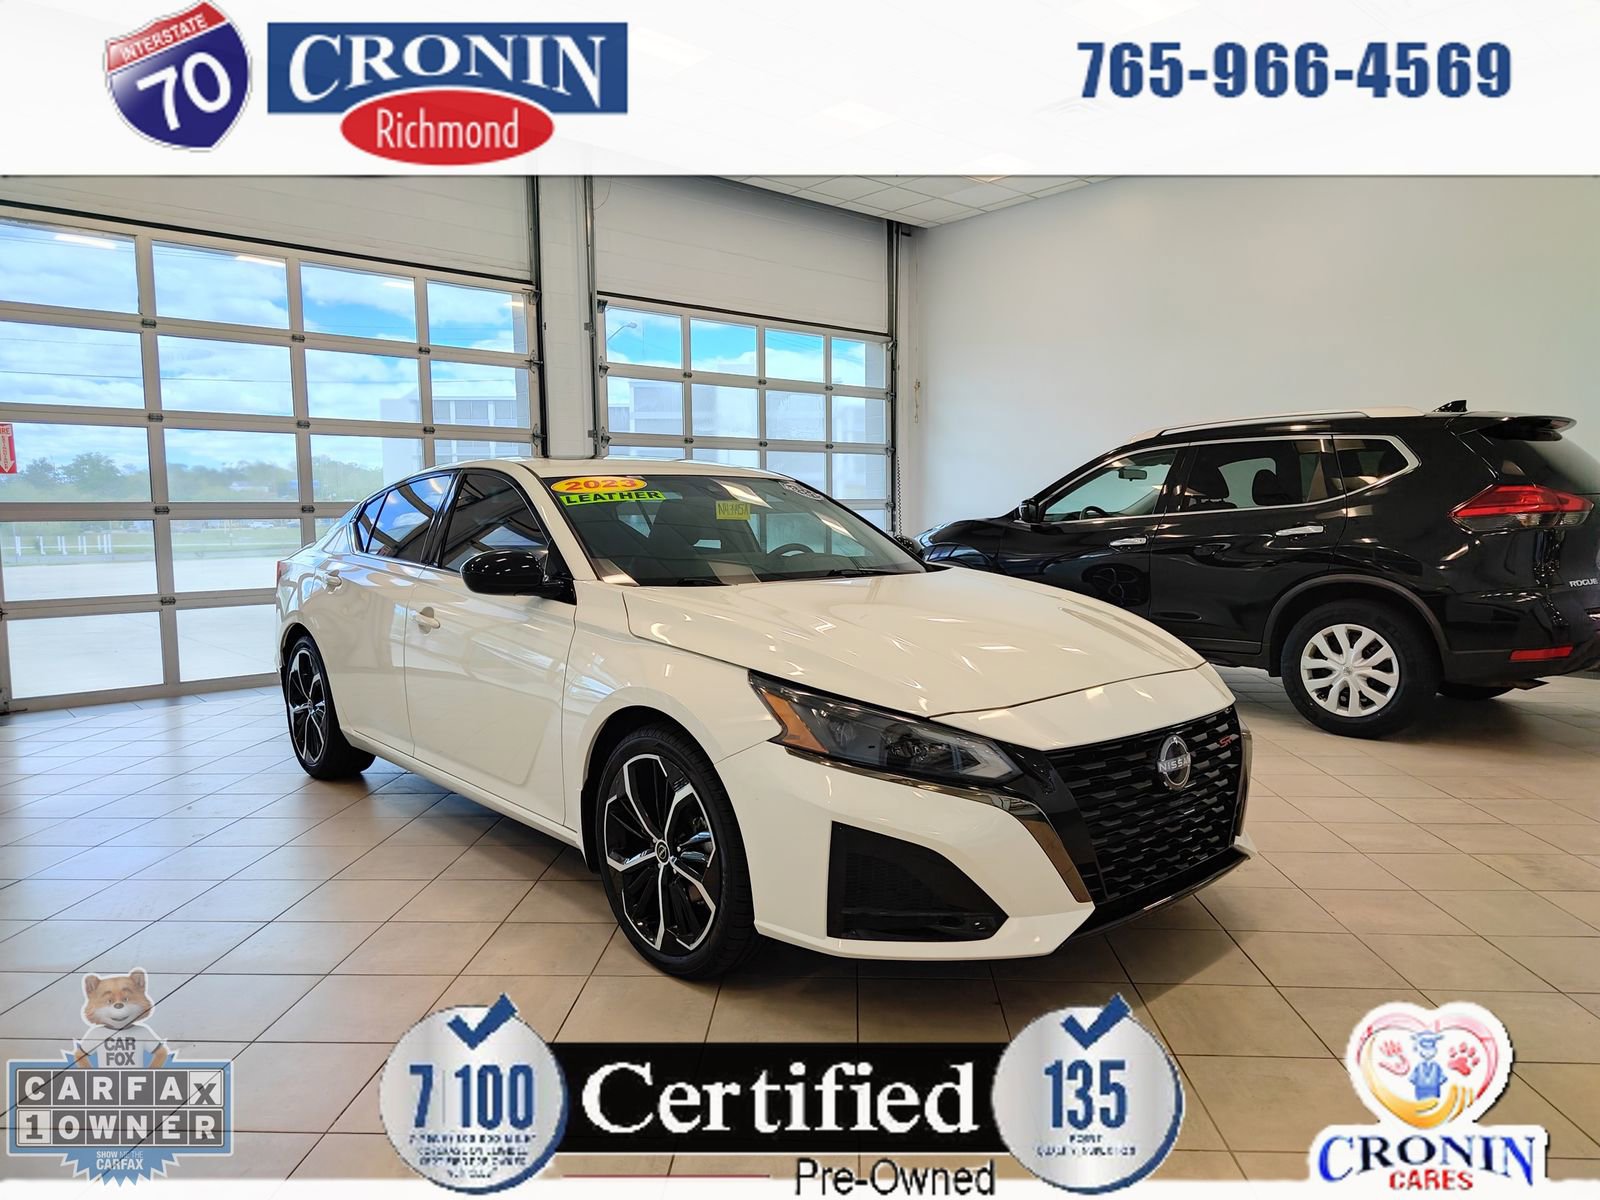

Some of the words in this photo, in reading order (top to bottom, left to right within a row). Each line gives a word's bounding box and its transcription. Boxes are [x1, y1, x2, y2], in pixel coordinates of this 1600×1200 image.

[565, 479, 637, 491] 2023
[565, 490, 662, 504] LEATHER
[1569, 577, 1599, 587] ROGUE
